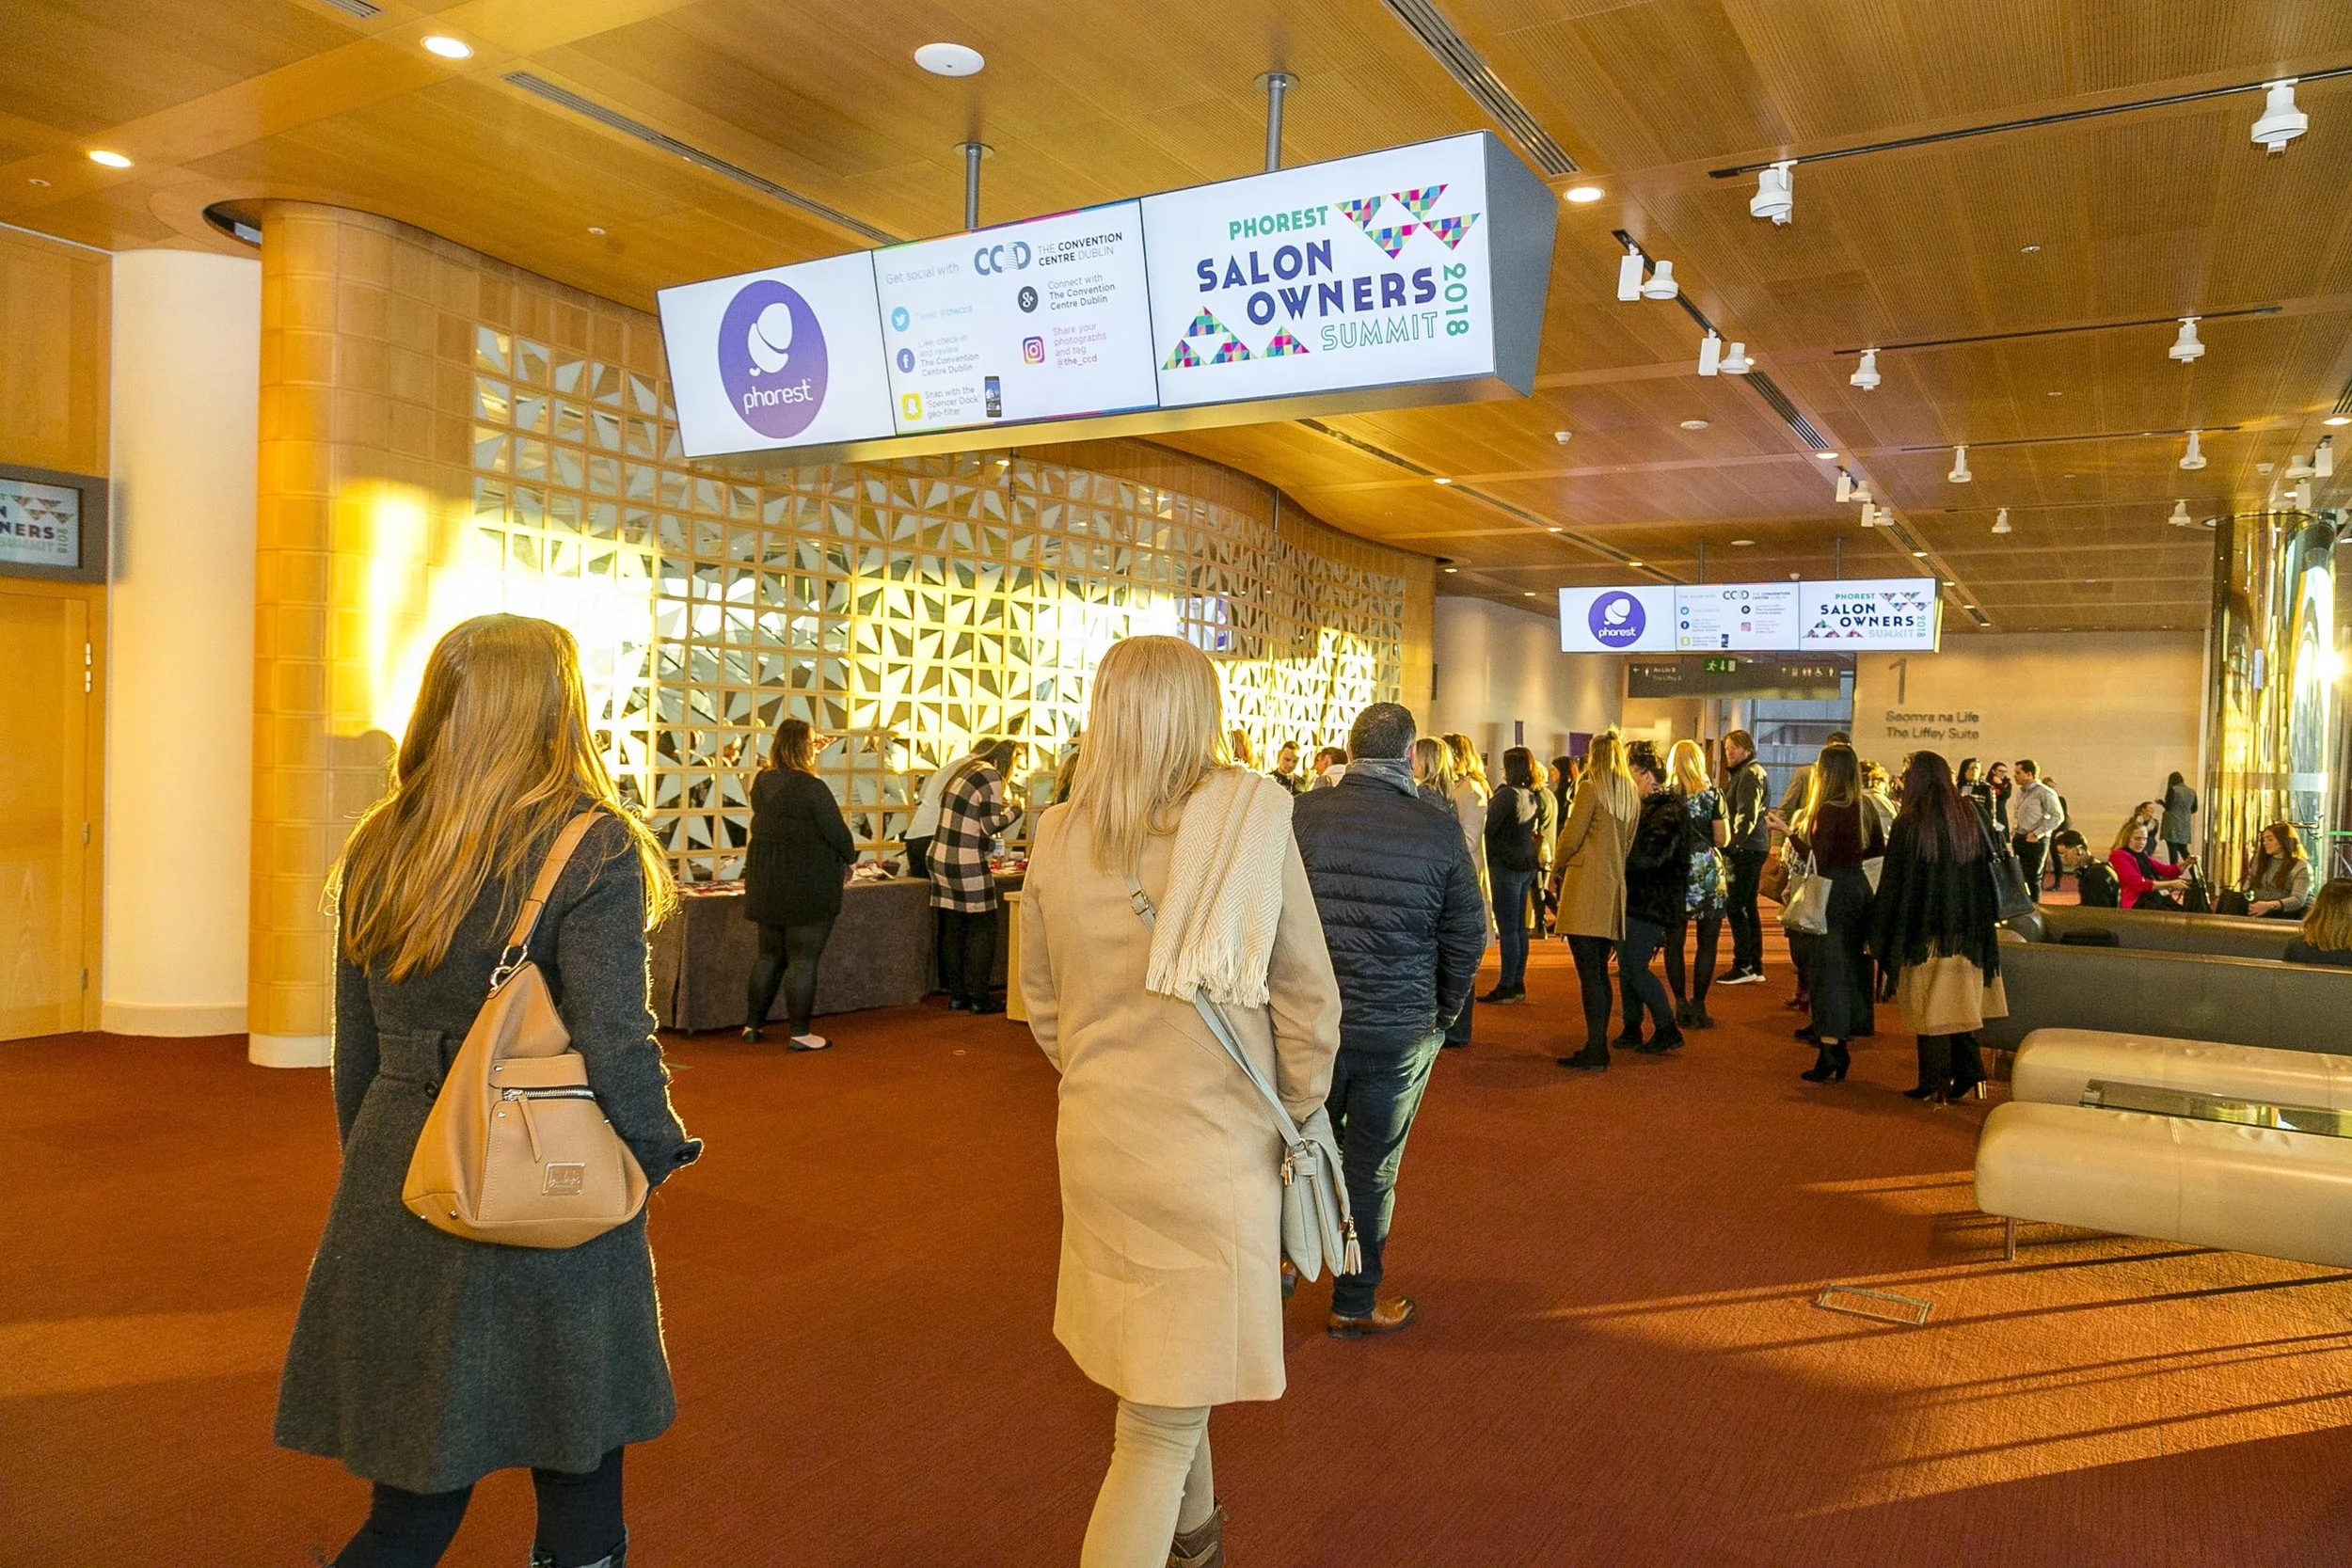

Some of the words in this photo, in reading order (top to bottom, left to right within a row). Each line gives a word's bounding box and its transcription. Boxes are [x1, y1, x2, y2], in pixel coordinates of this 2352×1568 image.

[1229, 205, 1328, 240] PHOREST
[1038, 244, 1056, 255] THE
[1057, 232, 1122, 251] CONVENTION
[1039, 252, 1075, 266] CENTRE
[1077, 245, 1114, 261] DUBLIN
[885, 273, 903, 285] Get
[906, 266, 934, 281] social
[937, 261, 960, 276] with
[1197, 239, 1334, 293] SALON
[1048, 277, 1082, 290] Connect
[1085, 274, 1104, 285] with
[1049, 292, 1064, 300] The
[1067, 283, 1115, 297] Convention
[1247, 266, 1437, 325] OWNERS
[1443, 262, 1470, 337] 2018
[1050, 300, 1077, 310] Centre
[1080, 294, 1108, 307] Dublin
[1053, 326, 1075, 337] Share
[1078, 323, 1097, 335] your
[1321, 311, 1438, 352] SUMMIT
[1054, 332, 1107, 347] photographs
[1055, 347, 1071, 357] and
[1073, 346, 1087, 356] tag
[920, 358, 933, 368] The
[936, 353, 979, 366] Convention
[922, 367, 946, 377] Centre
[948, 364, 973, 374] Dublin
[743, 378, 814, 415] phorest
[925, 389, 943, 400] Snap
[945, 387, 961, 396] with
[962, 386, 975, 394] the
[1820, 603, 1876, 615] SALON
[1840, 616, 1915, 627] OWNERS
[1916, 615, 1926, 638] 2018
[1598, 626, 1636, 639] phorest
[1868, 628, 1915, 639] SUMMIT
[1889, 657, 1907, 705] 1
[1885, 710, 1935, 722] Seomra
[1938, 713, 1953, 722] na
[1957, 711, 1979, 722] Life
[1886, 726, 1909, 737] The
[1912, 726, 1946, 740] Liffey
[1948, 727, 1979, 739] Suite
